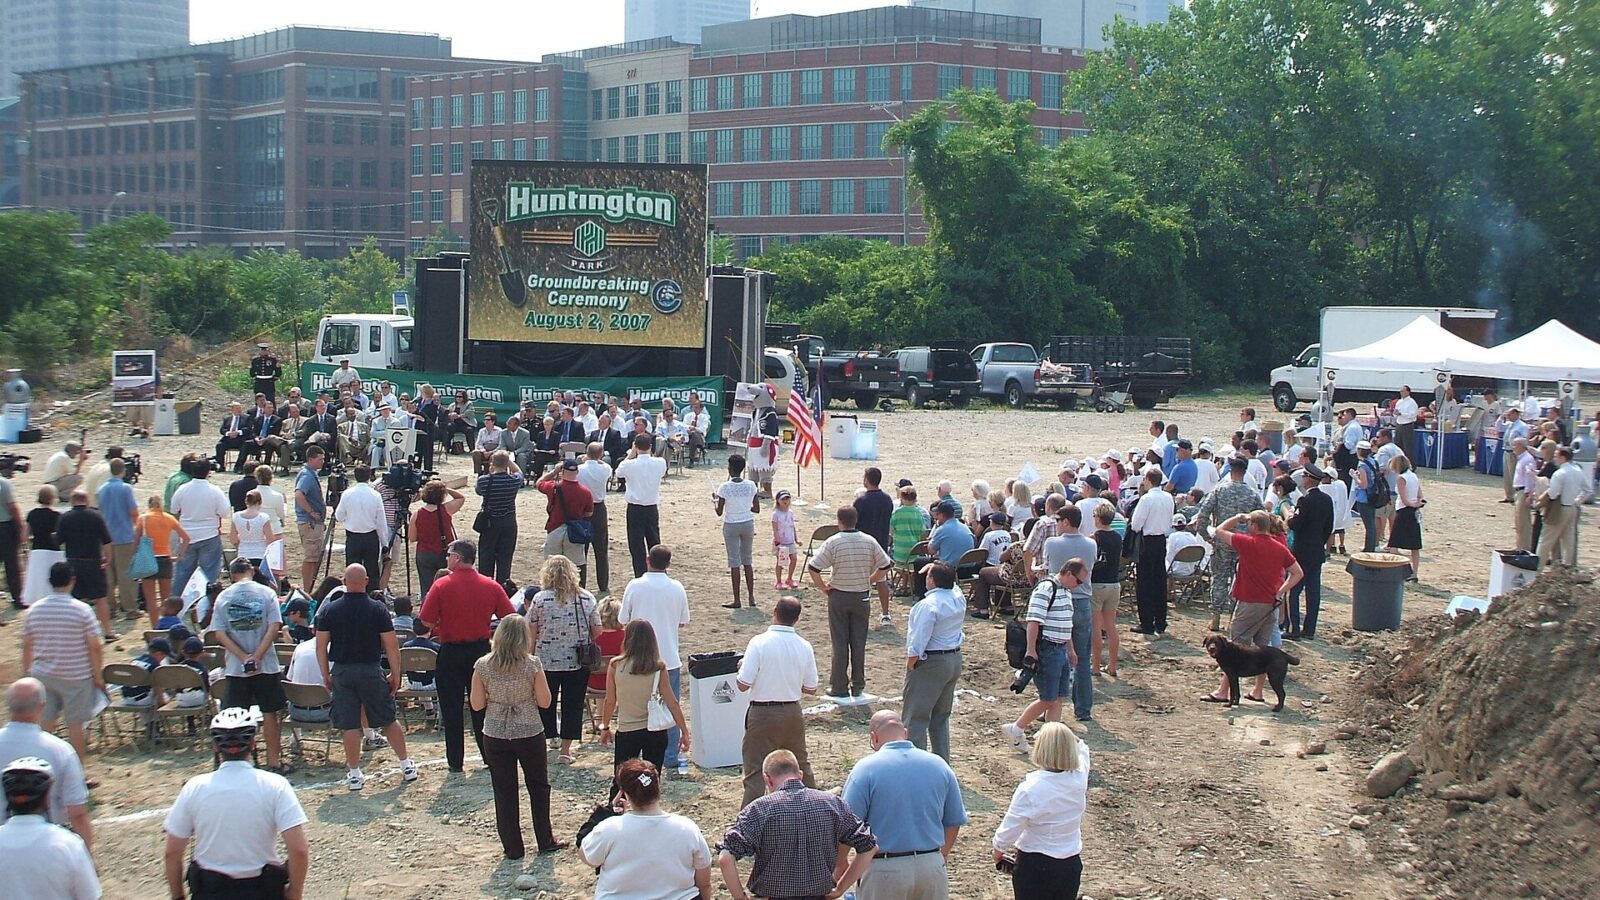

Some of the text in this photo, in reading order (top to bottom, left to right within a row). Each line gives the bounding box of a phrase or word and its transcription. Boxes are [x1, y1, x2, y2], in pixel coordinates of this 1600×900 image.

[509, 186, 672, 222] Huntington
[571, 259, 603, 270] PARK
[527, 274, 650, 294] Groundbreaking
[547, 291, 628, 311] Ceremony
[524, 310, 652, 332] August 2, 2007
